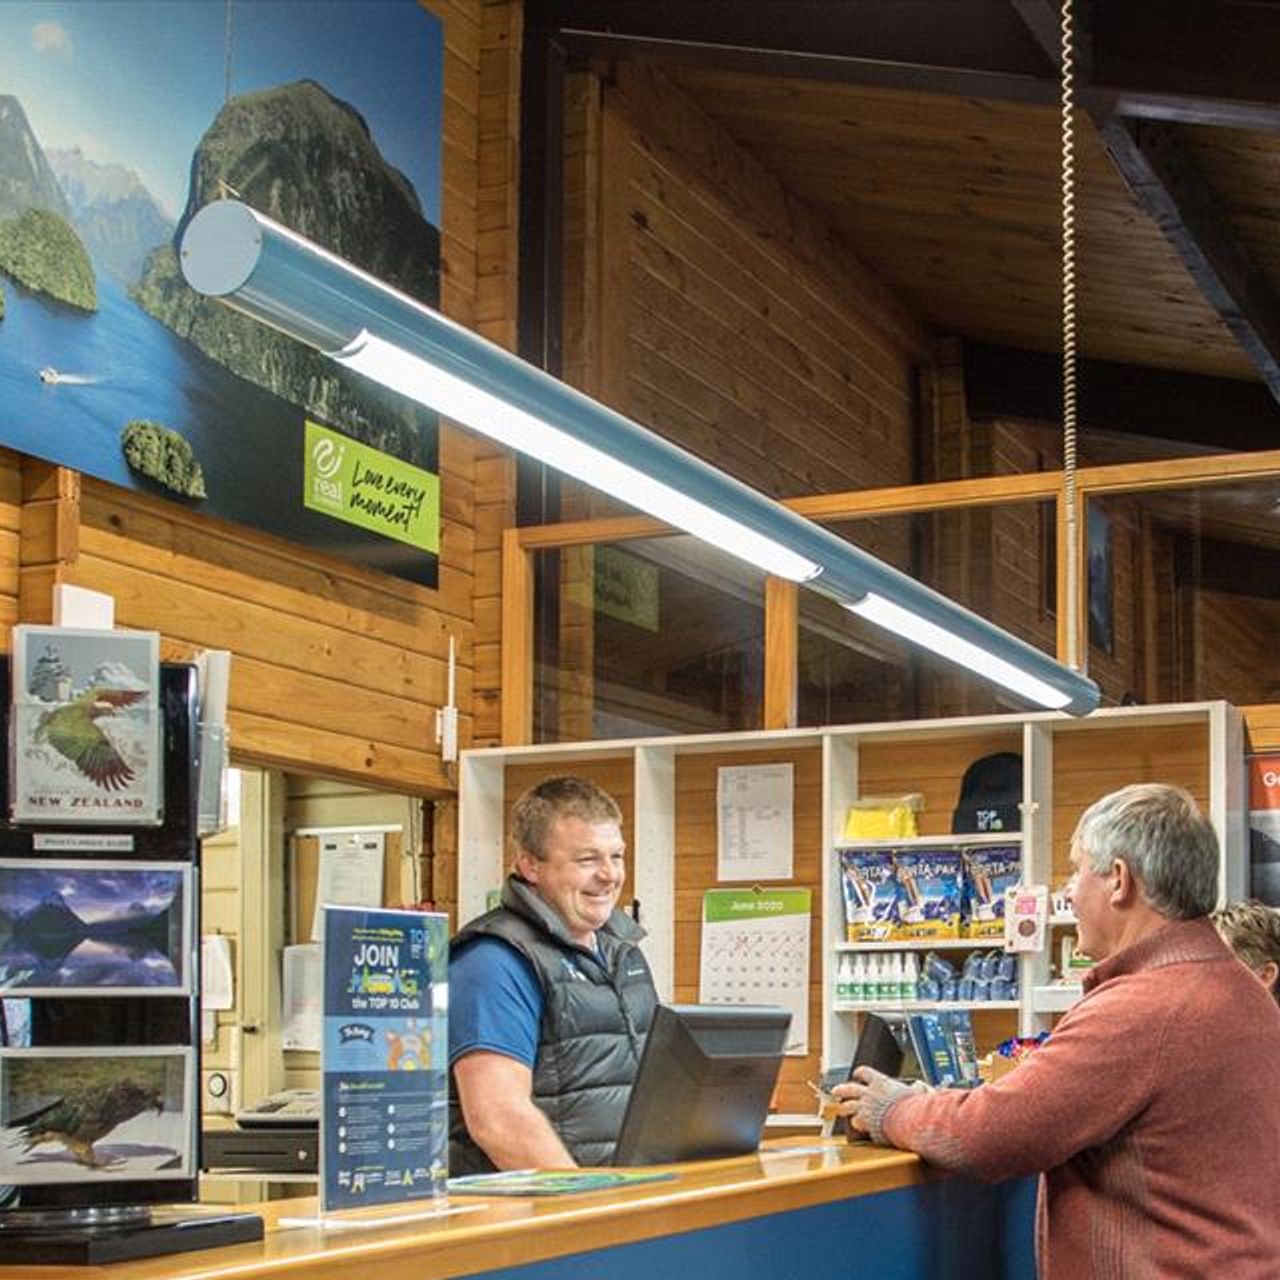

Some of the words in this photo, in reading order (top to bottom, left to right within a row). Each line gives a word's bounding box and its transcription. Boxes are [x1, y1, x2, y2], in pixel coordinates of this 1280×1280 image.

[352, 459, 383, 490] Love
[386, 476, 425, 518] every
[28, 797, 61, 807] NEW
[71, 796, 144, 808] ZEALAND
[353, 944, 400, 967] JOIN
[351, 998, 368, 1009] the
[368, 997, 388, 1009] TOP
[389, 998, 399, 1009] 10
